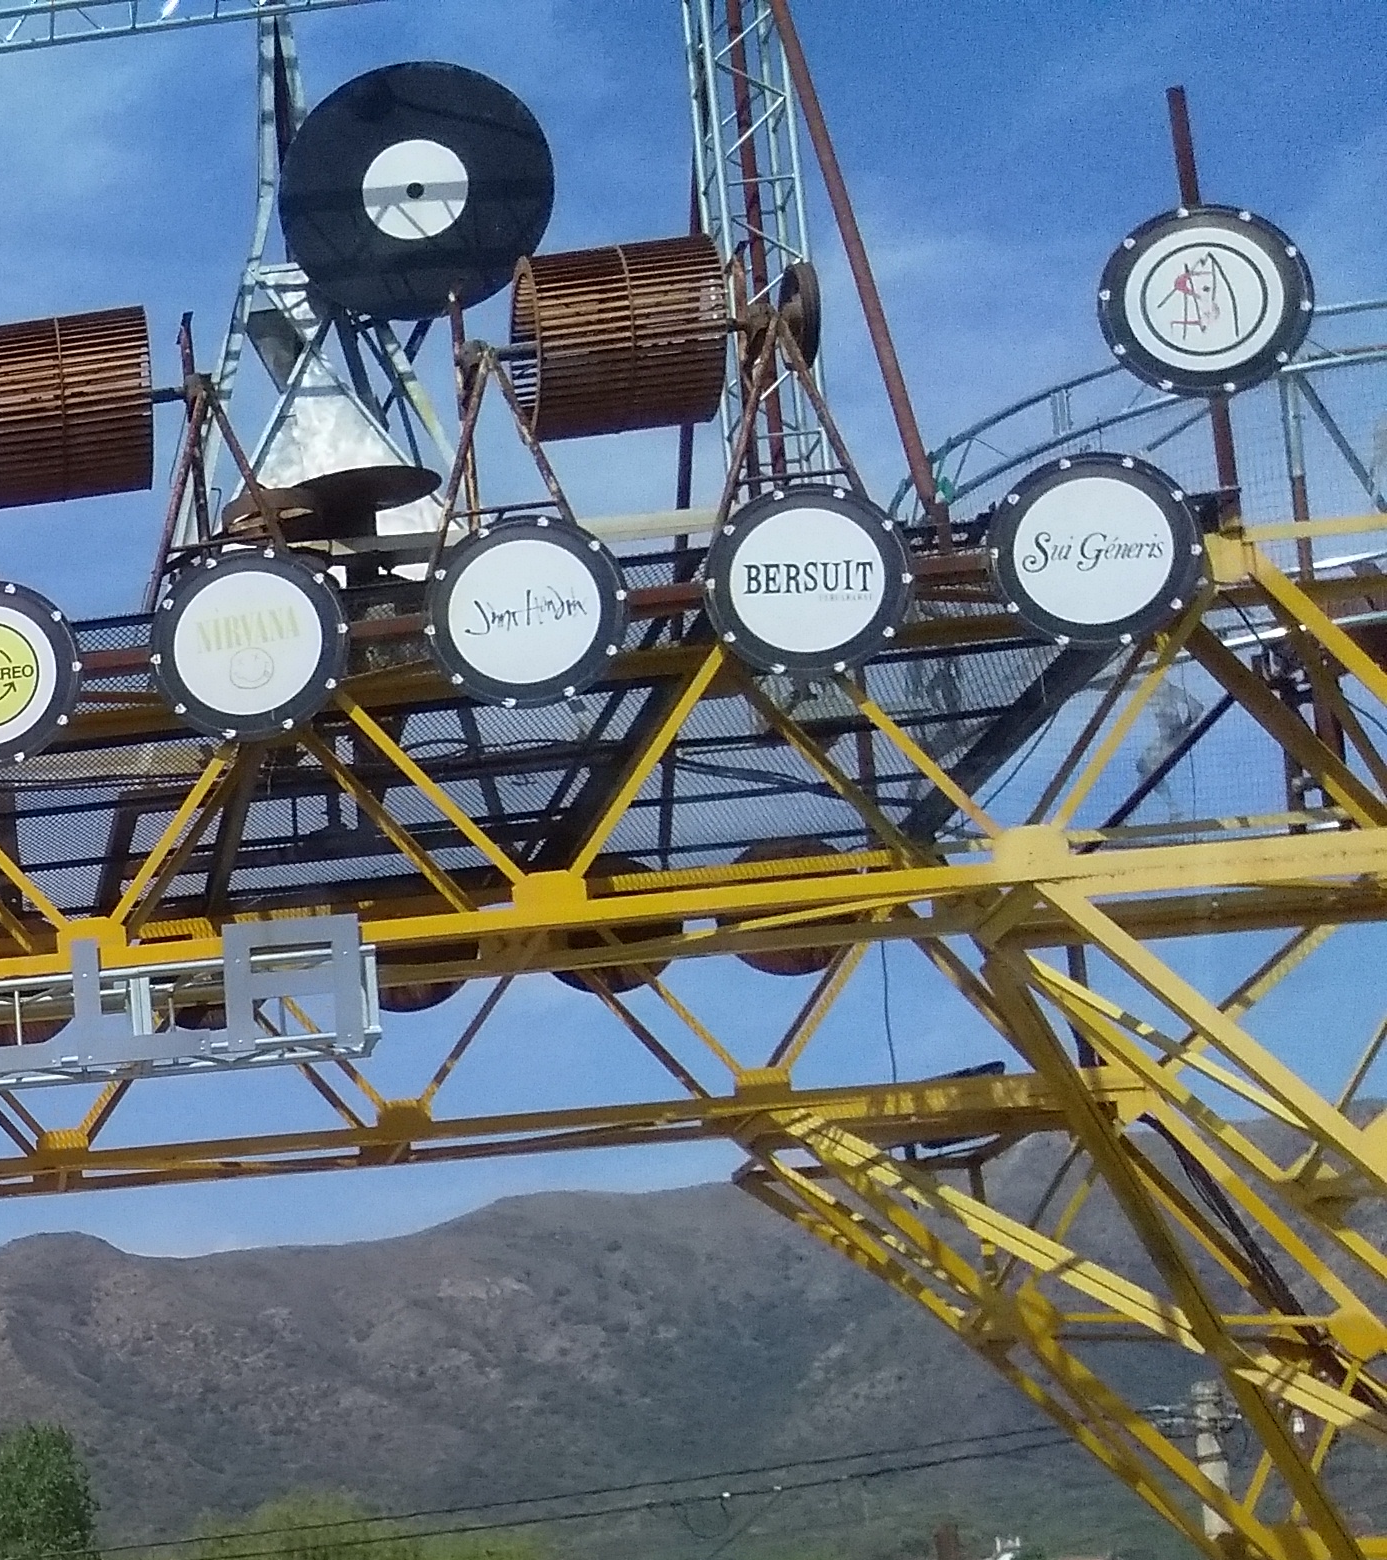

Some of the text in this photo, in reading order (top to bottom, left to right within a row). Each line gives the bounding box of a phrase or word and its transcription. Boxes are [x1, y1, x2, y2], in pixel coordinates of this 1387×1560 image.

[1022, 532, 1164, 573] Sui Géneris
[743, 560, 873, 595] BERSUIT
